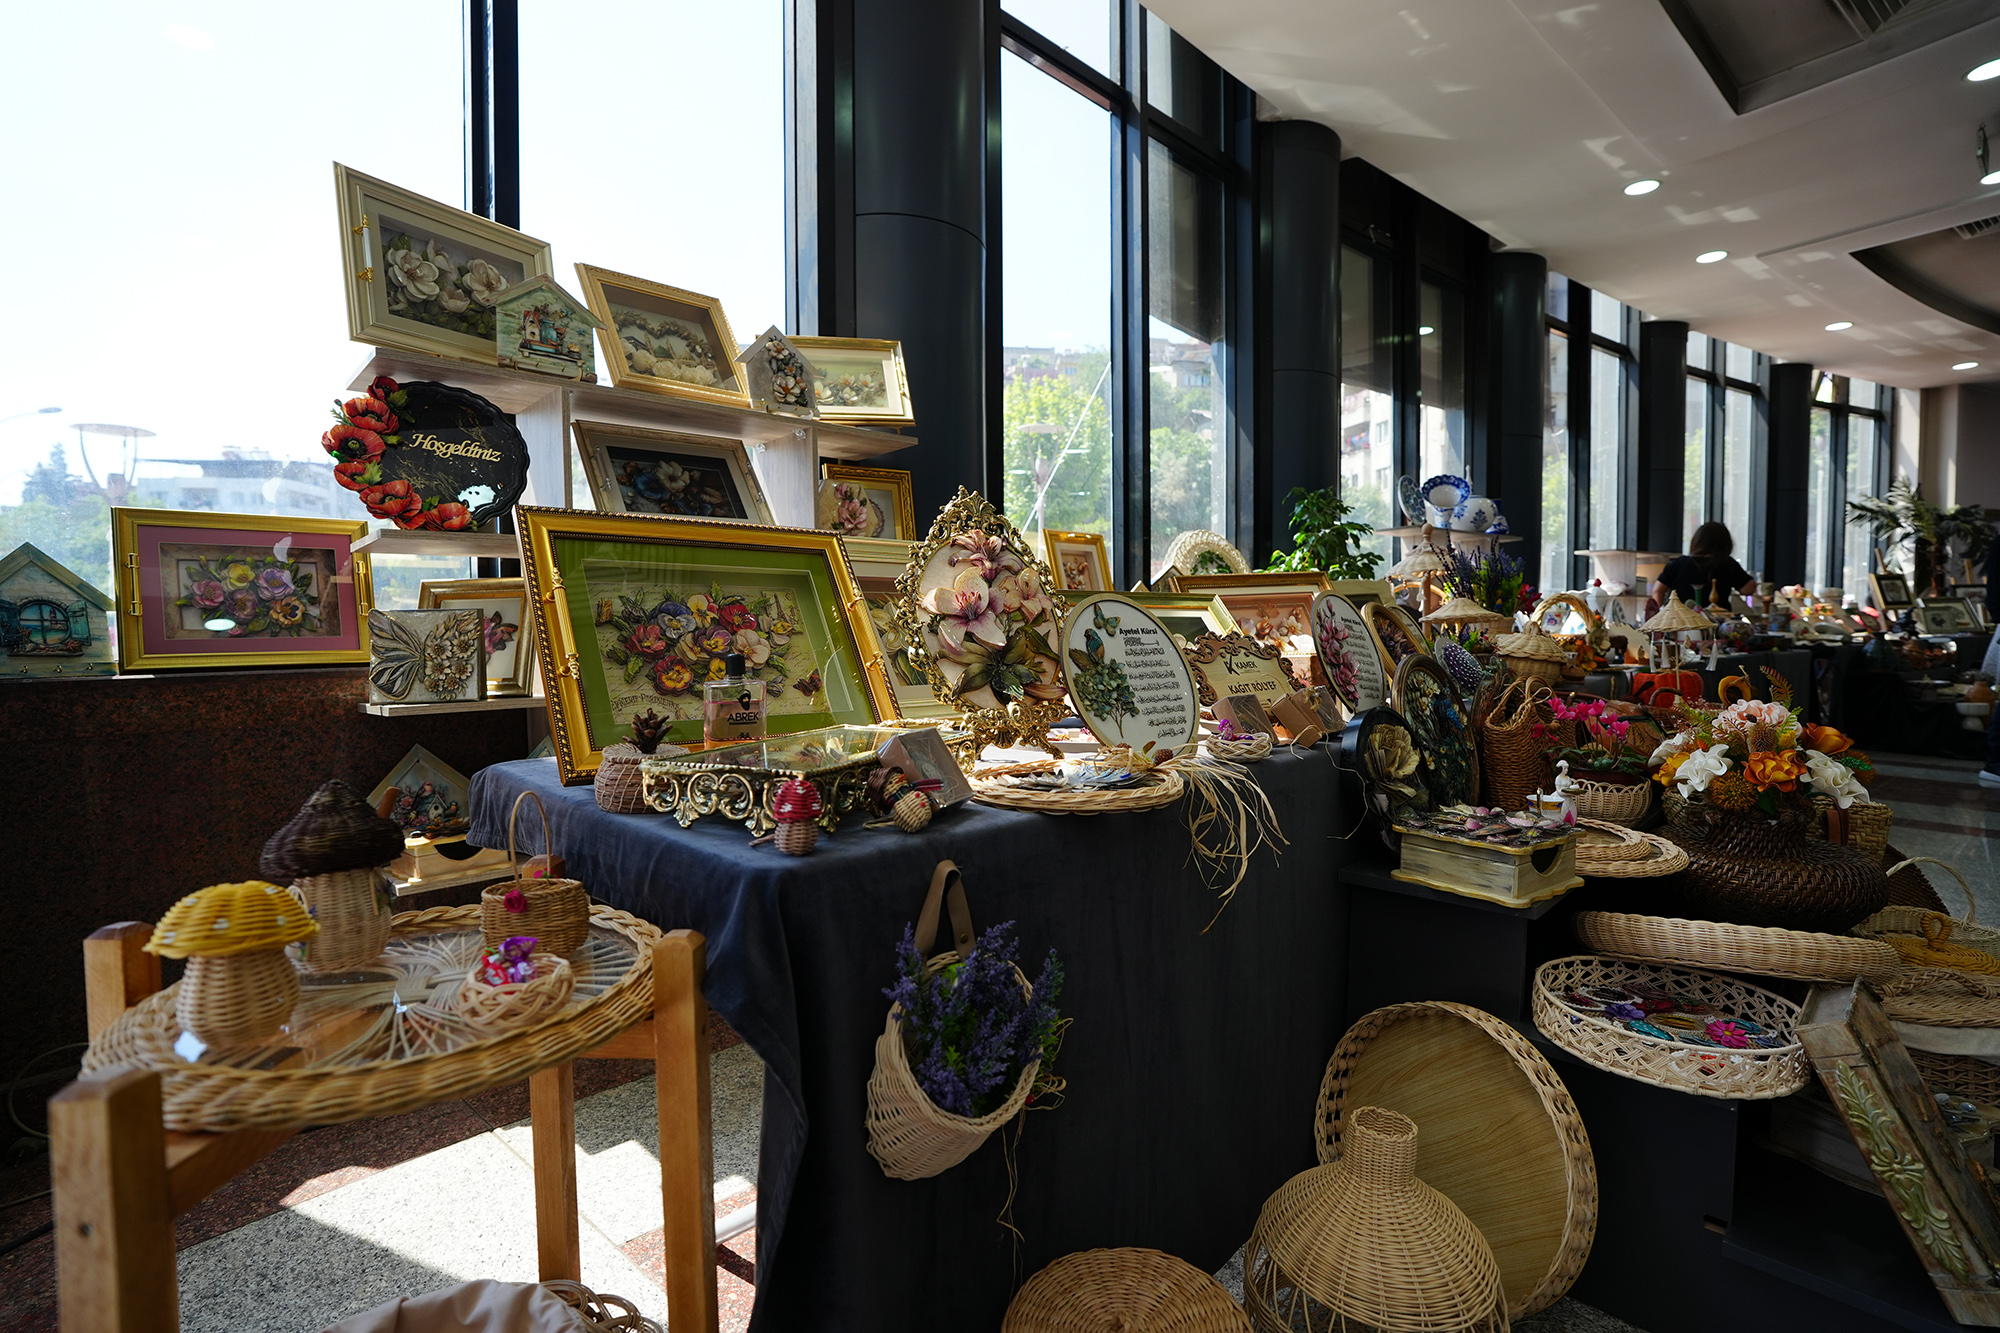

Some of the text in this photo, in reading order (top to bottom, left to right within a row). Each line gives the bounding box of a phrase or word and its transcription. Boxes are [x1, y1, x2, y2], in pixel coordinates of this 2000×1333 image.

[409, 433, 502, 462] Hoşgeldiniz
[1119, 627, 1158, 636] Ayetel Kürsi
[1251, 680, 1277, 692] RÖLYEF
[727, 712, 760, 722] ABREK
